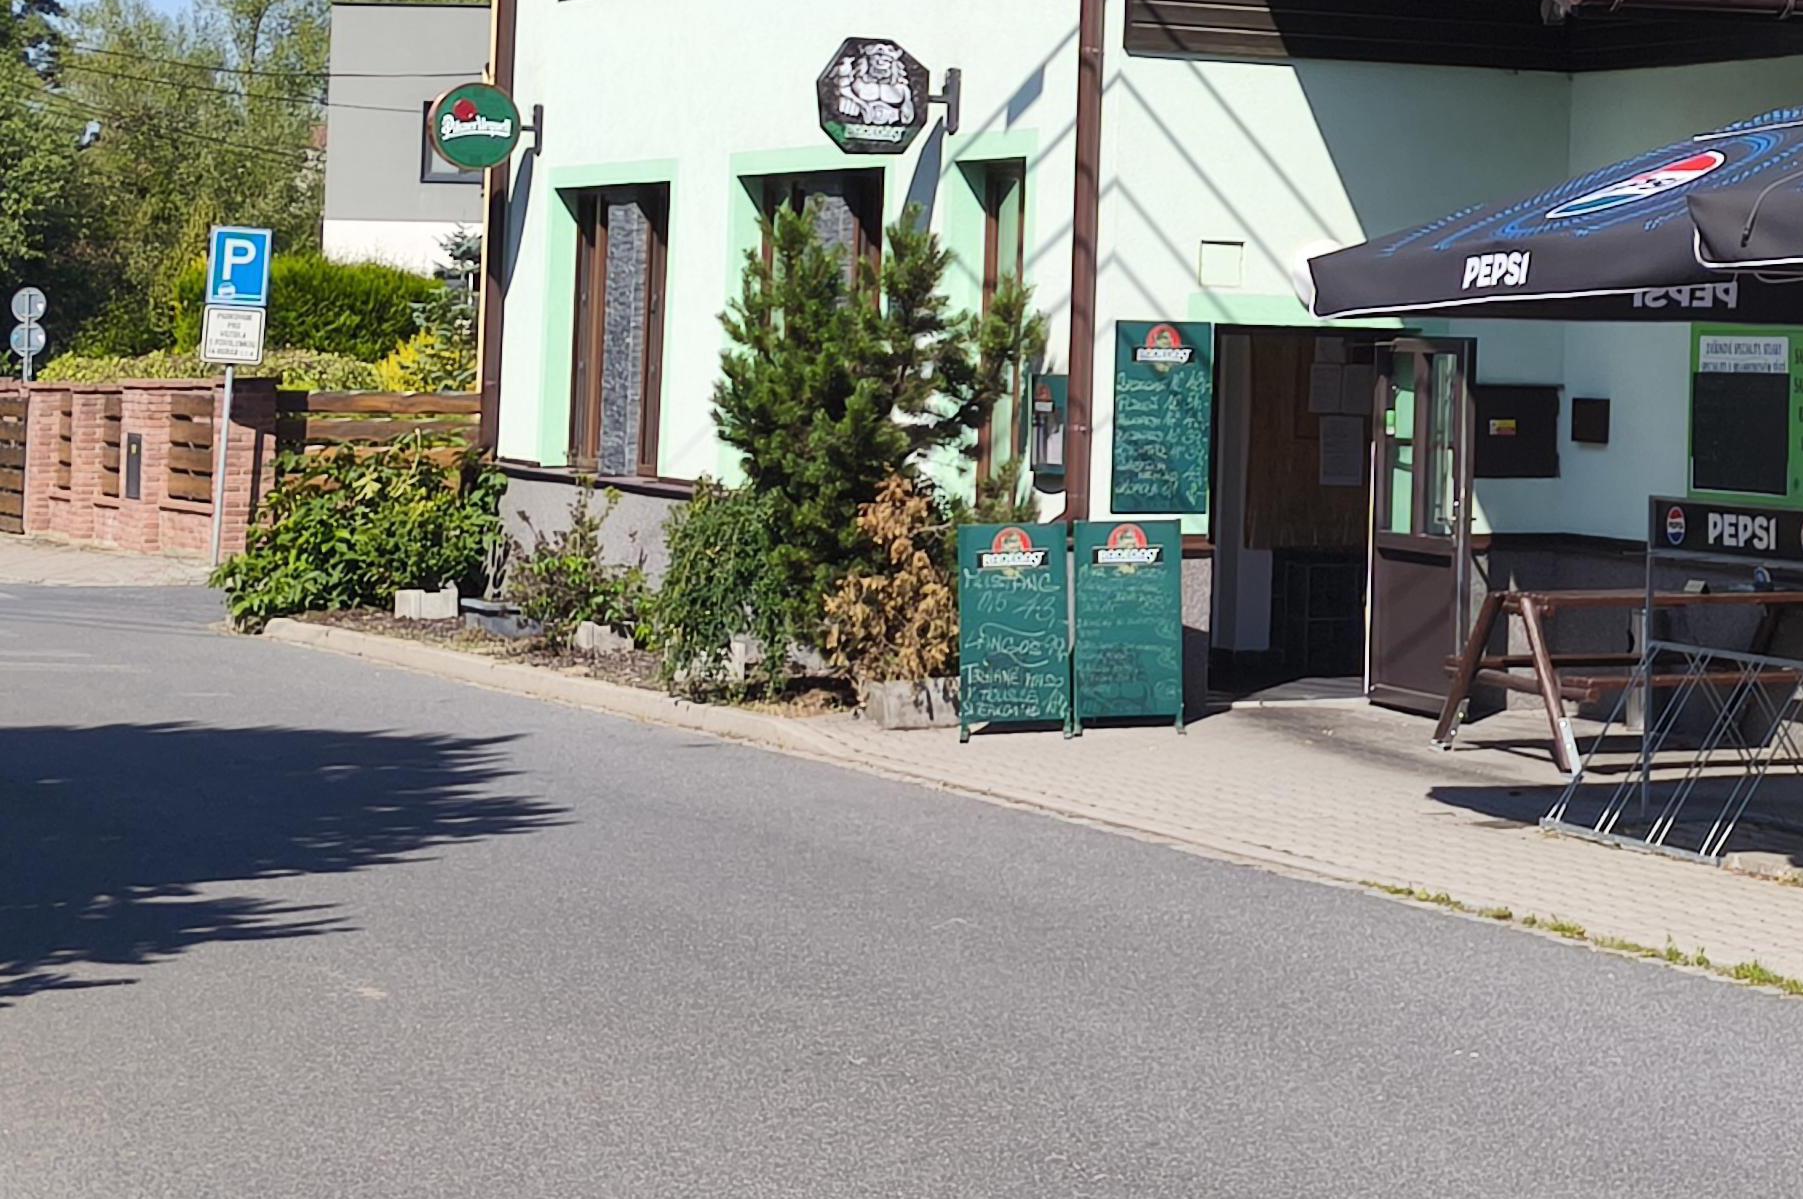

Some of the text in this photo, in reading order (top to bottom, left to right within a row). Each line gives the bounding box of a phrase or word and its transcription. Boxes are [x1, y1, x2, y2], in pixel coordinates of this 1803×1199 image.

[222, 238, 256, 280] P
[1461, 250, 1531, 290] PEPSI
[1708, 512, 1776, 550] PEPSI
